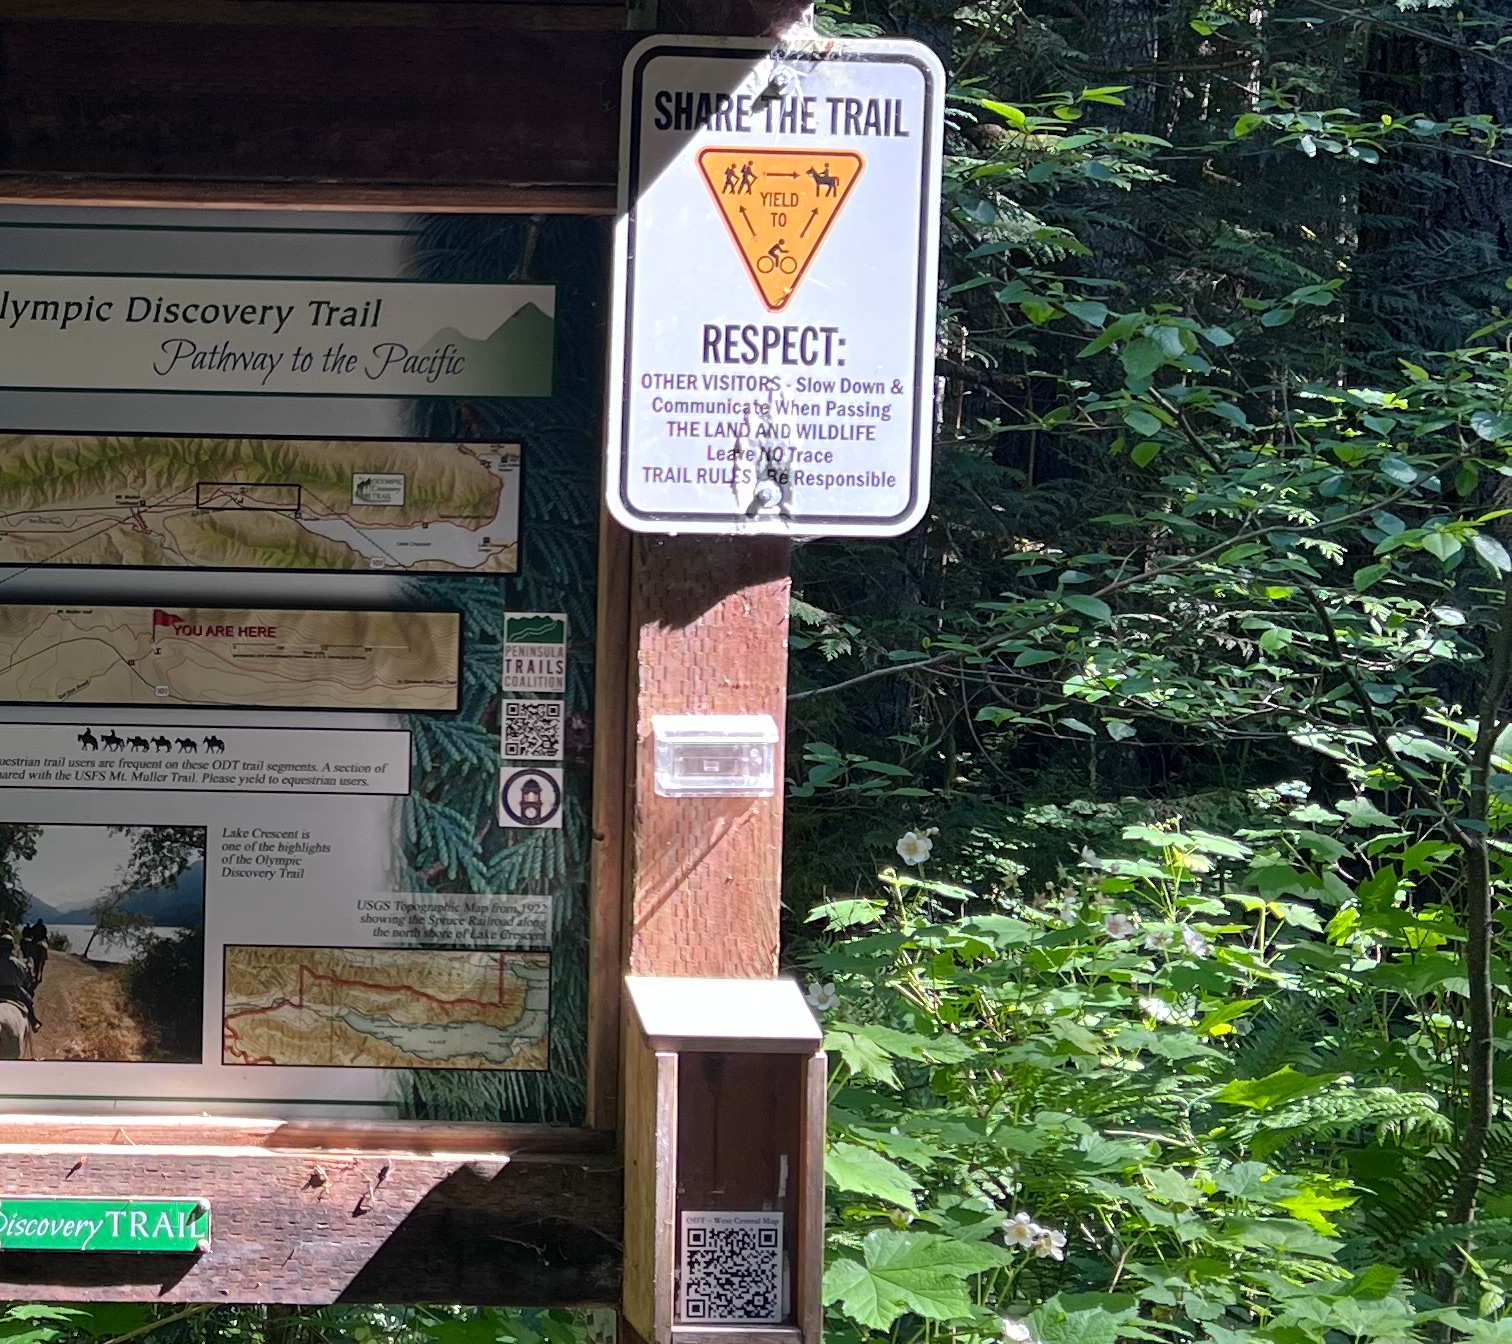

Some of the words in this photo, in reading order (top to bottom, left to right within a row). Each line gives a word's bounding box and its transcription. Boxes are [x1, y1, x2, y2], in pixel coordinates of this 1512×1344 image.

[654, 90, 751, 132] SHARE
[761, 94, 817, 135] THE
[826, 97, 910, 138] TRAIL
[759, 192, 799, 208] YIELD
[770, 212, 787, 228] TO
[125, 296, 294, 335] Discovery
[309, 298, 383, 329] Trail
[702, 323, 847, 367] RESPECT:
[153, 338, 284, 386] Pathway
[291, 346, 313, 373] to
[321, 343, 357, 374] the
[364, 342, 465, 383] Pacific
[641, 373, 698, 390] OTHER
[701, 374, 782, 392] VISITORS
[795, 377, 836, 393] Slow
[839, 377, 885, 395] Down
[890, 379, 904, 395] &
[652, 397, 771, 415] Communicate
[774, 399, 820, 416] When
[825, 400, 892, 422] Passing
[666, 420, 700, 437] THE
[704, 421, 751, 439] LAND
[754, 422, 792, 439] AND
[796, 423, 877, 441] WILDLIFE
[707, 445, 755, 462] Leave
[759, 446, 784, 463] NO
[787, 446, 834, 463] Trace
[642, 466, 693, 484] TRAIL
[696, 467, 752, 484] RULES
[794, 470, 897, 488] Responsible
[172, 623, 203, 638] YOU
[205, 623, 233, 639] ARE
[236, 624, 277, 639] HERE
[504, 644, 564, 658] PENINSULA
[504, 658, 564, 675] TRAILS
[503, 675, 563, 689] COALITION
[43, 757, 65, 767] trail
[68, 760, 95, 768] users
[118, 758, 161, 772] frequent
[181, 759, 209, 770] these
[211, 760, 239, 770] ODT
[242, 760, 263, 771] trail
[266, 761, 319, 775] segments.
[321, 762, 330, 772] A
[333, 762, 371, 773] section
[374, 763, 388, 773] of
[28, 769, 51, 780] with
[54, 770, 71, 780] the
[74, 770, 105, 781] USFS
[108, 771, 128, 781] Mt.
[131, 771, 167, 782] Muller
[201, 772, 235, 783] Please
[238, 773, 265, 786] yield
[268, 774, 279, 784] to
[281, 774, 336, 788] equestrian
[221, 827, 249, 839] Lake
[251, 828, 299, 839] Crescent
[301, 829, 310, 839] is
[221, 843, 242, 852] one
[244, 841, 257, 852] of
[258, 842, 275, 852] the
[277, 842, 331, 855] highlights
[221, 854, 235, 865] of
[236, 854, 252, 865] the
[255, 854, 303, 870] Olympic
[221, 867, 276, 881] Discovery
[279, 868, 305, 879] Trail
[105, 1211, 207, 1239] TRAIL
